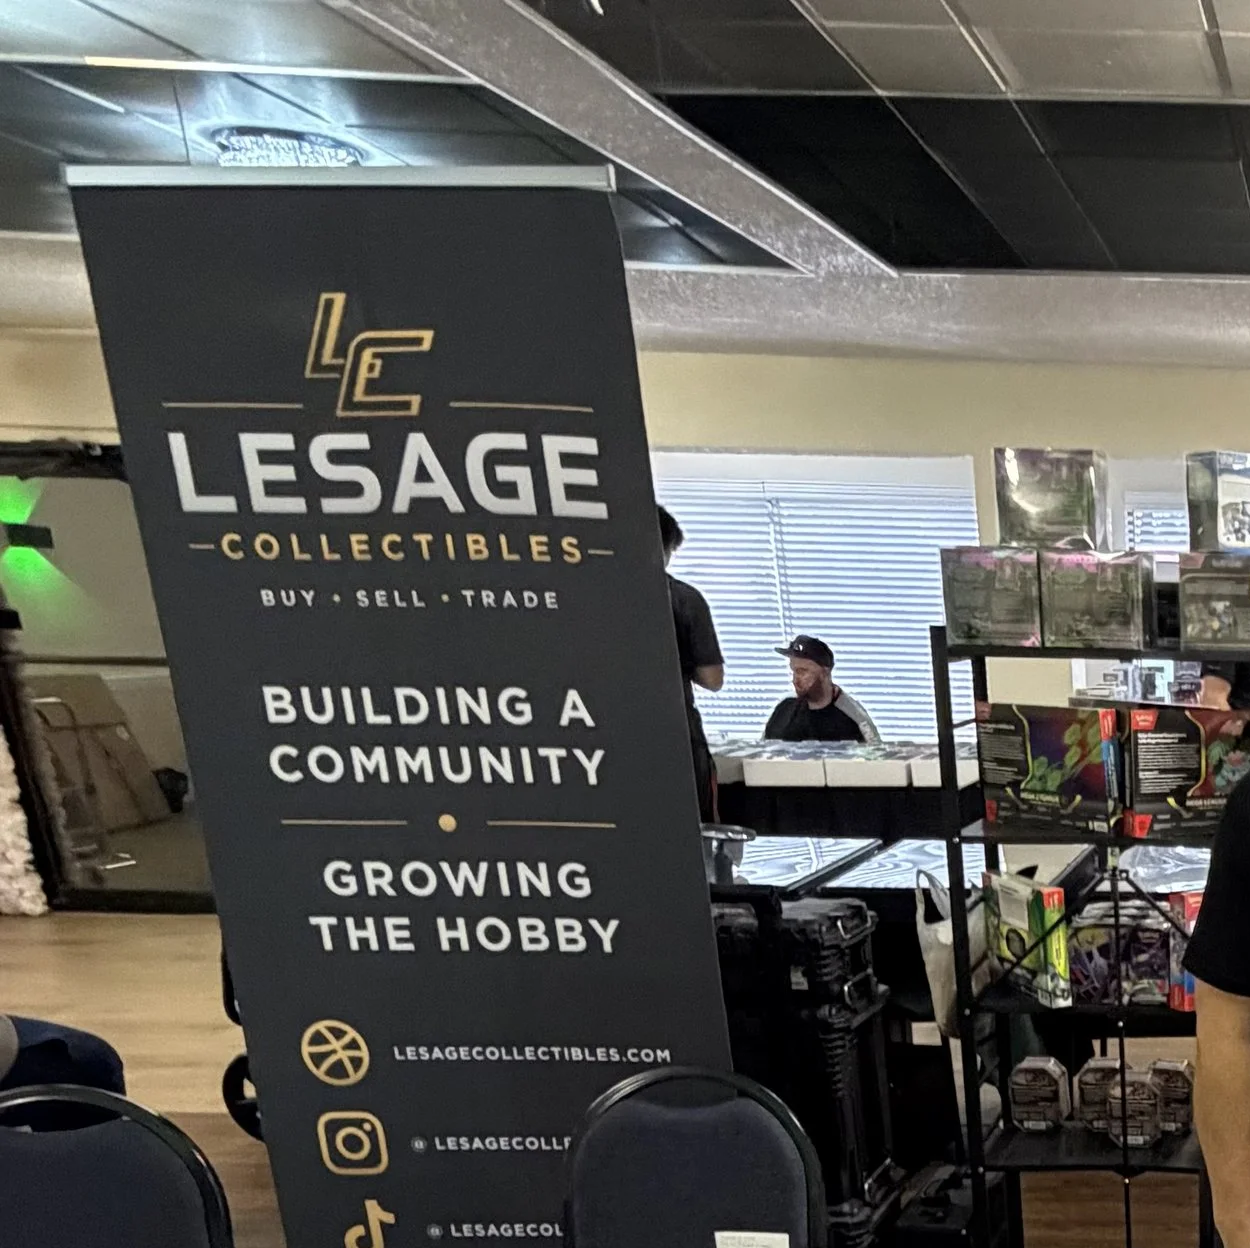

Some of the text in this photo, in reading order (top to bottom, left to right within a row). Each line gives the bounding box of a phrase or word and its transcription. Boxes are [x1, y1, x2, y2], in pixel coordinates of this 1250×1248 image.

[168, 433, 607, 518] LESAGE
[221, 533, 581, 563] COLLECTIBLES
[261, 589, 557, 608] BUY SELL TRADE
[263, 686, 595, 726] BUILDING A
[270, 745, 604, 784] COMMUNITY
[324, 861, 591, 897] GROWING
[309, 917, 619, 952] THE HOBBY
[394, 1046, 670, 1062] LESAGECOLLECTIBLES.COM
